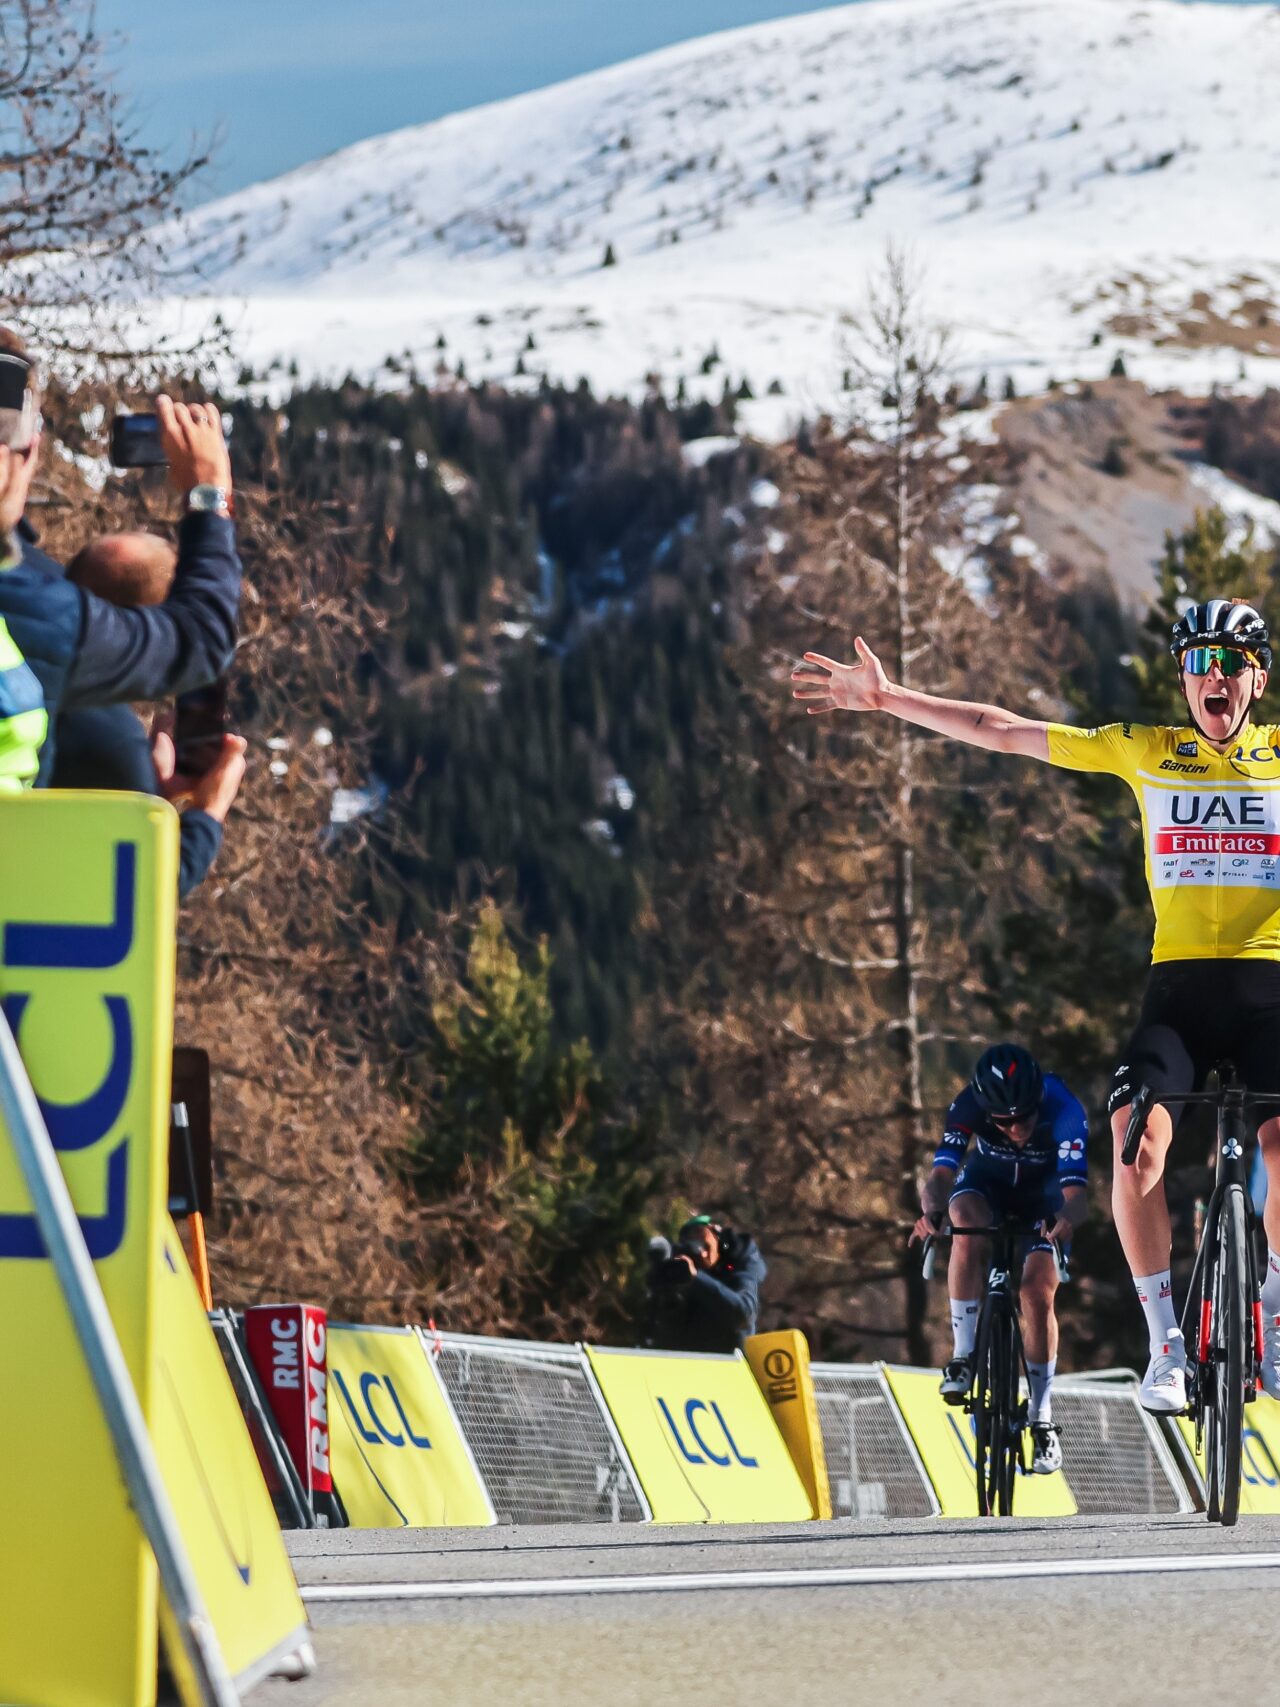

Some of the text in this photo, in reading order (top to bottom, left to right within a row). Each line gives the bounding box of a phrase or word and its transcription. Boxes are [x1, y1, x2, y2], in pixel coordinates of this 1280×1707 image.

[1159, 760, 1209, 774] Santini
[1171, 795, 1265, 825] UAE
[1172, 835, 1266, 852] Emirates
[271, 1317, 300, 1390] RMC
[307, 1317, 331, 1475] RMC
[332, 1368, 432, 1450] LCL
[656, 1396, 760, 1468] LCL
